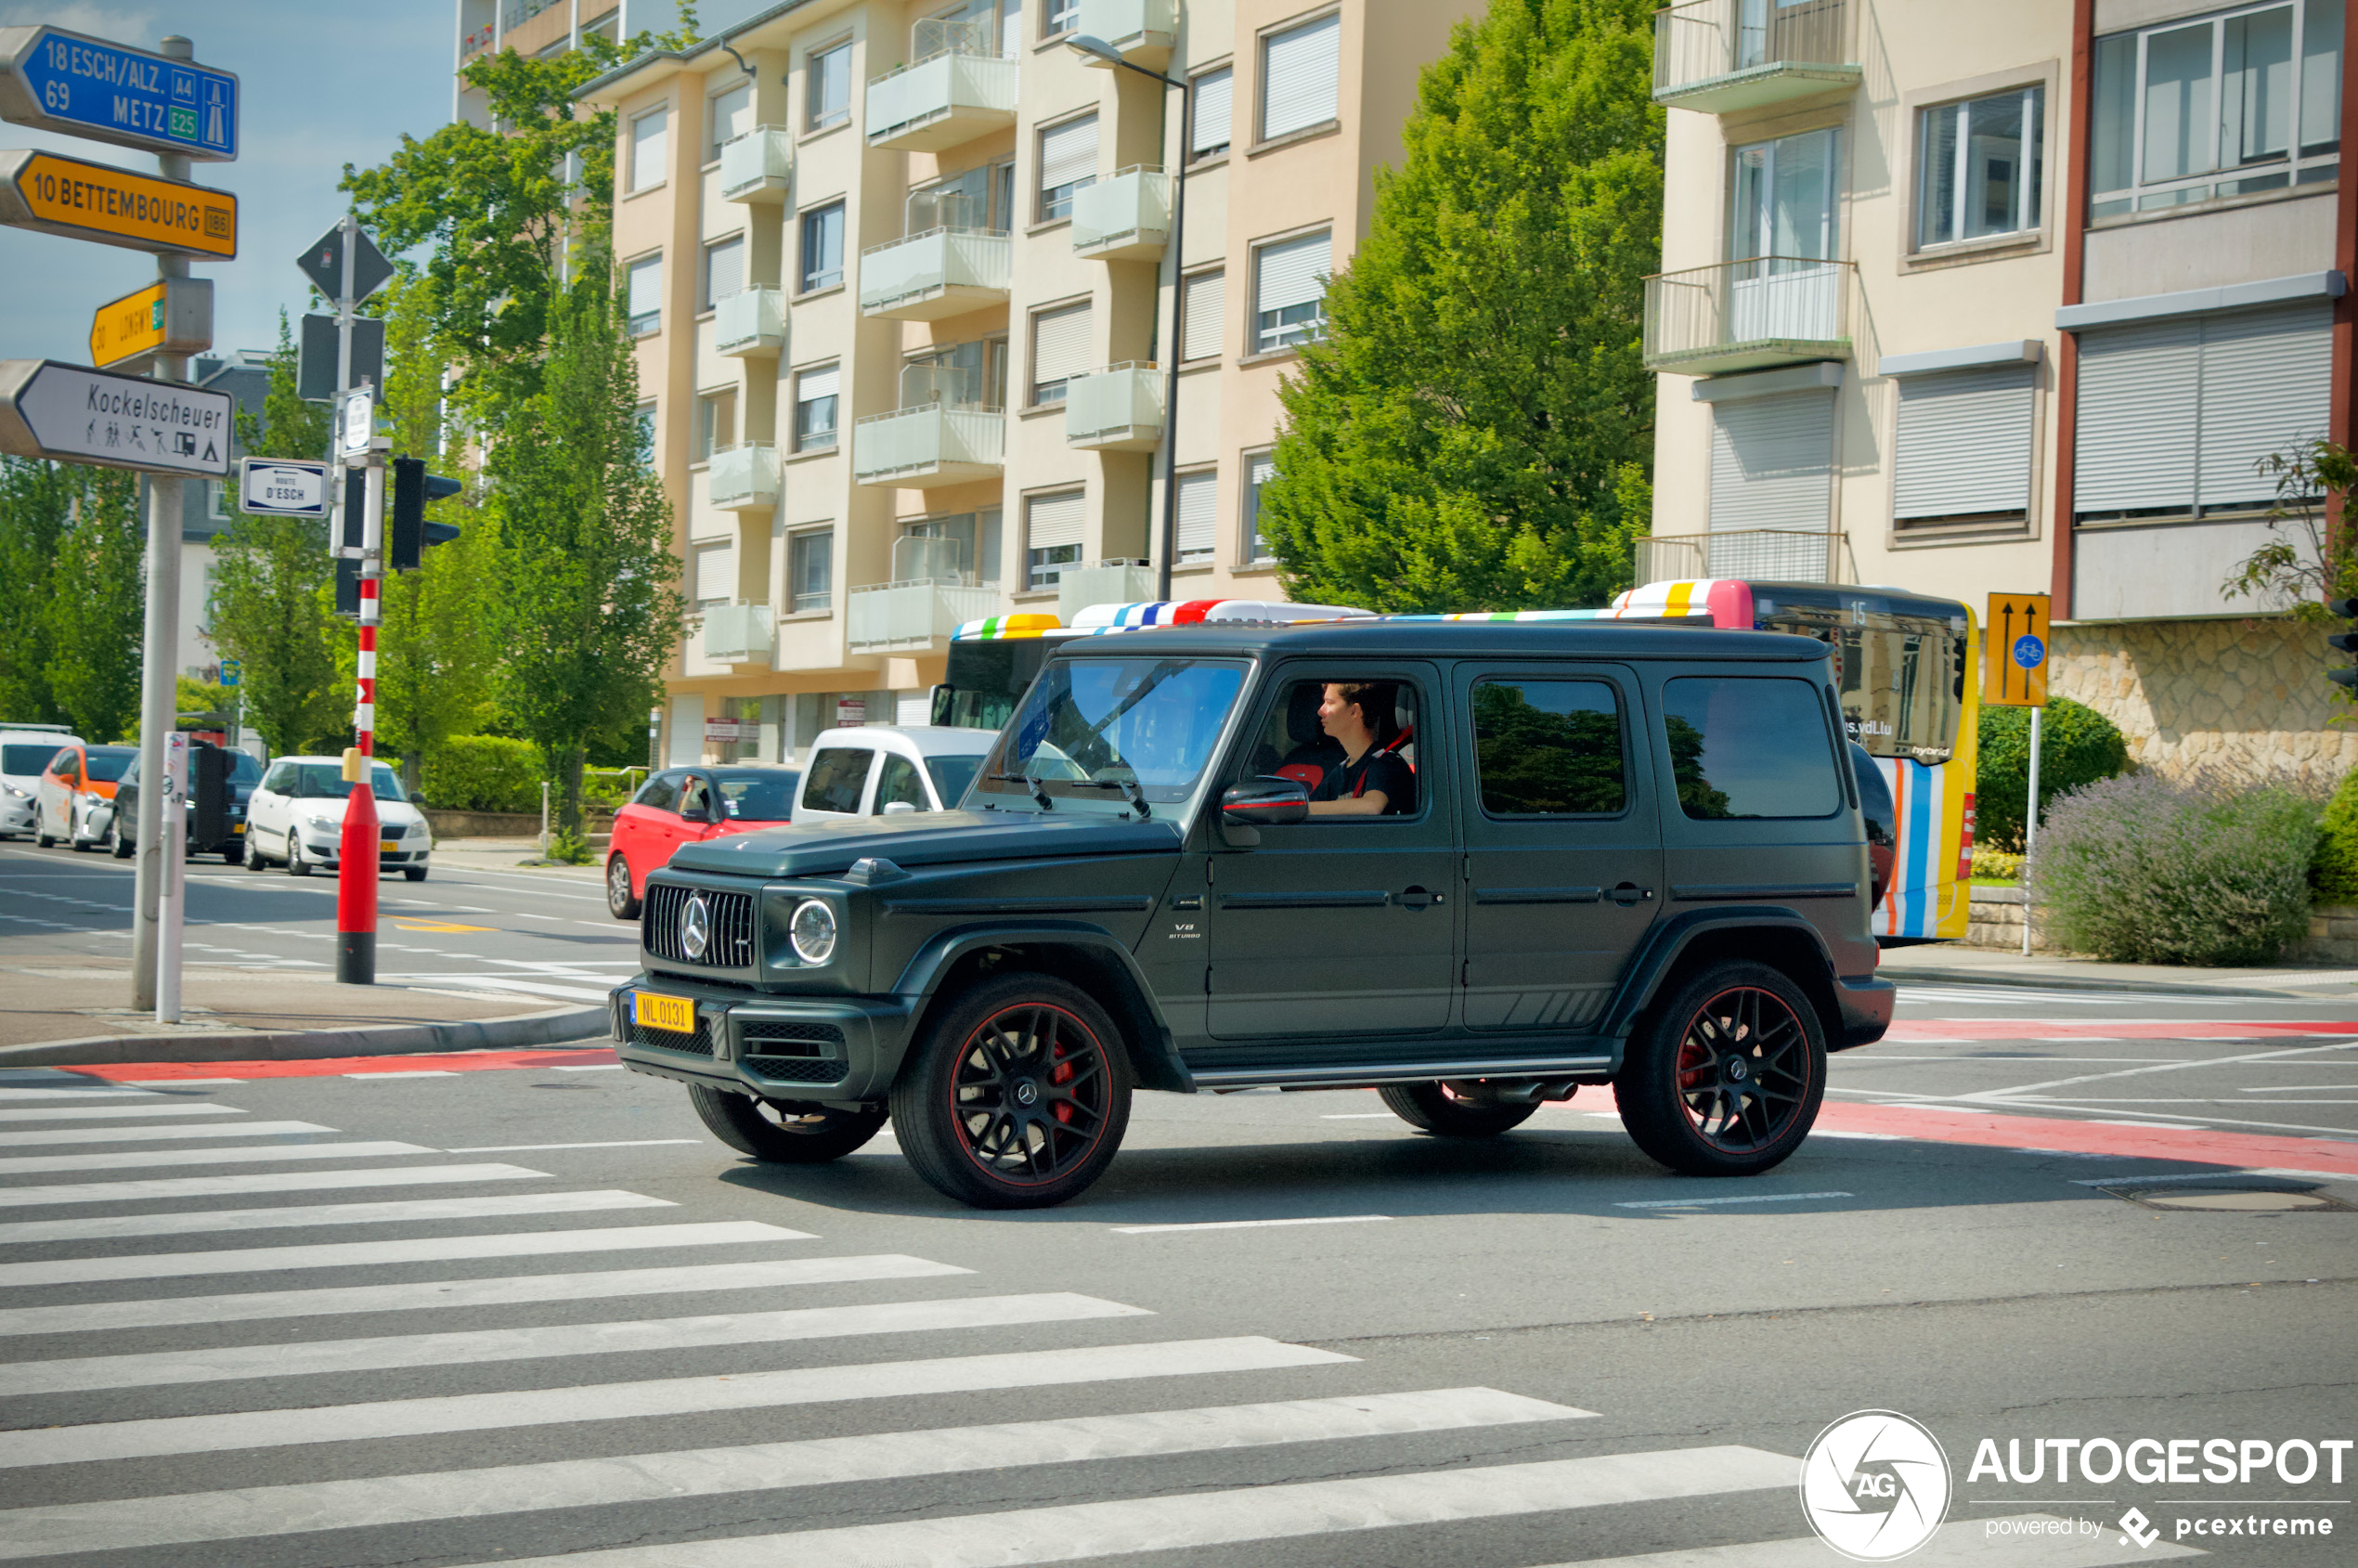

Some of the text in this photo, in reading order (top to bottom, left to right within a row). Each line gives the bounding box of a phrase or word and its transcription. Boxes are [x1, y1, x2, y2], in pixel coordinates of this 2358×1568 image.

[46, 40, 192, 97] 18 ESCH/ALZ. A4
[45, 79, 195, 135] 69 METZ E25
[34, 173, 227, 232] 10 BETTEMBOURG 186
[87, 383, 222, 430] Kockelscheuer
[266, 486, 304, 500] D'ESCH
[1851, 601, 1867, 626] 15
[1911, 745, 1950, 758] hybrid
[642, 998, 685, 1027] NL 0131
